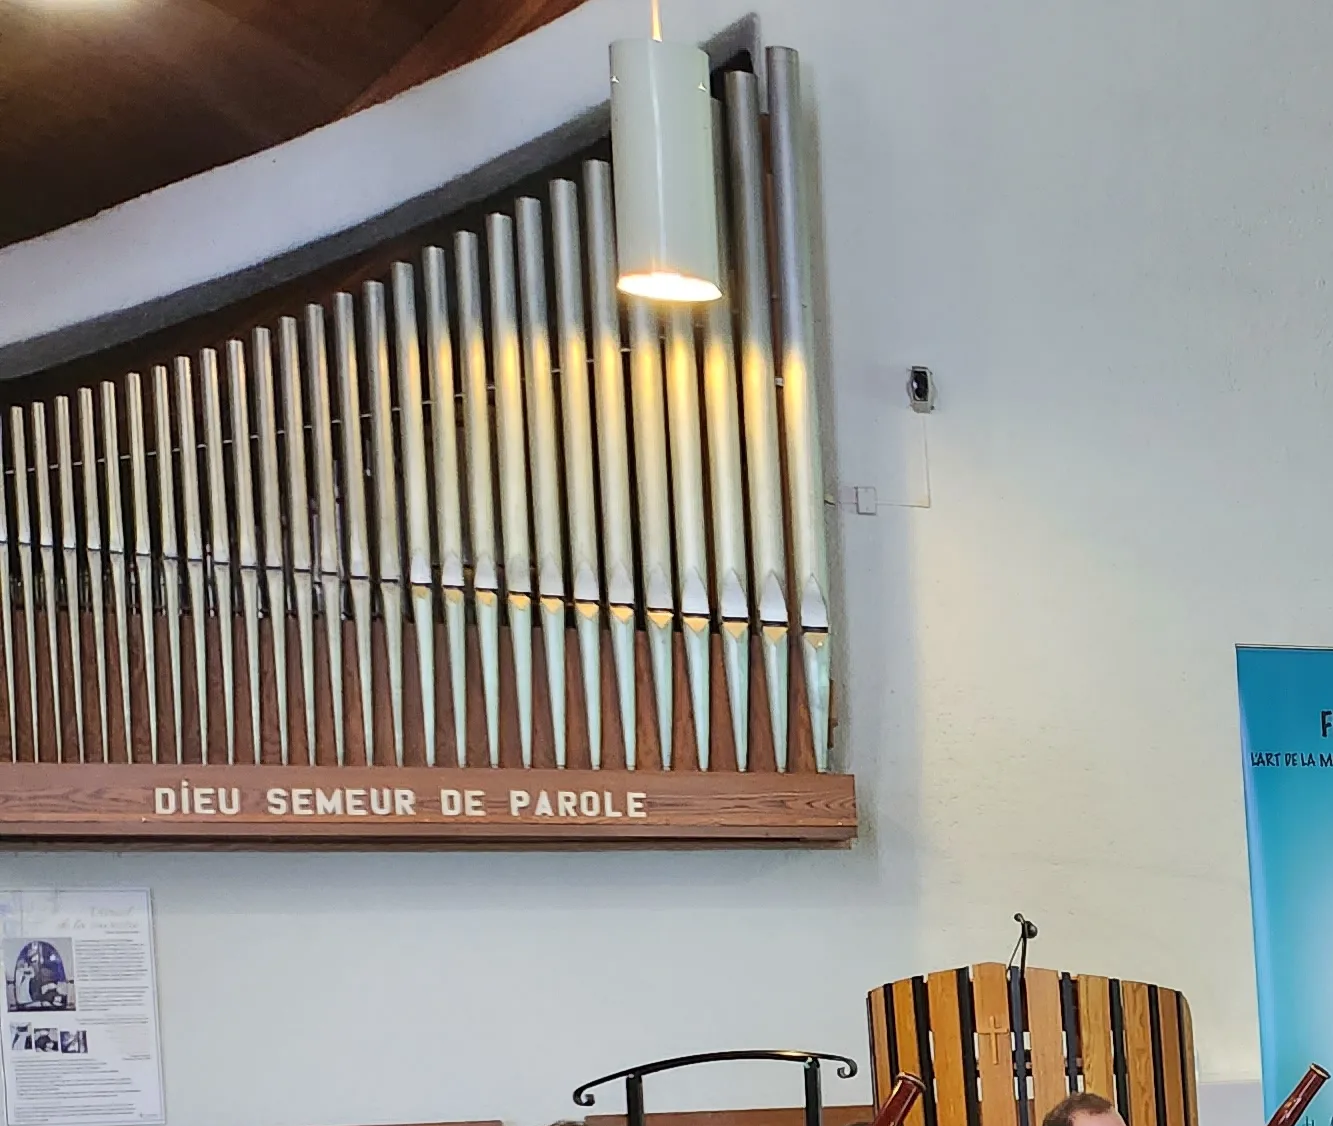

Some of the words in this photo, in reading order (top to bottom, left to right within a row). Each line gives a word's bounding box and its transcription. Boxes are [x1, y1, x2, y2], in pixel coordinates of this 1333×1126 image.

[1251, 751, 1281, 767] L'ART
[1285, 752, 1298, 767] DE
[1301, 752, 1316, 767] LA
[266, 787, 416, 816] SEMEUR
[440, 788, 487, 817] DE
[509, 790, 648, 818] PAROLE
